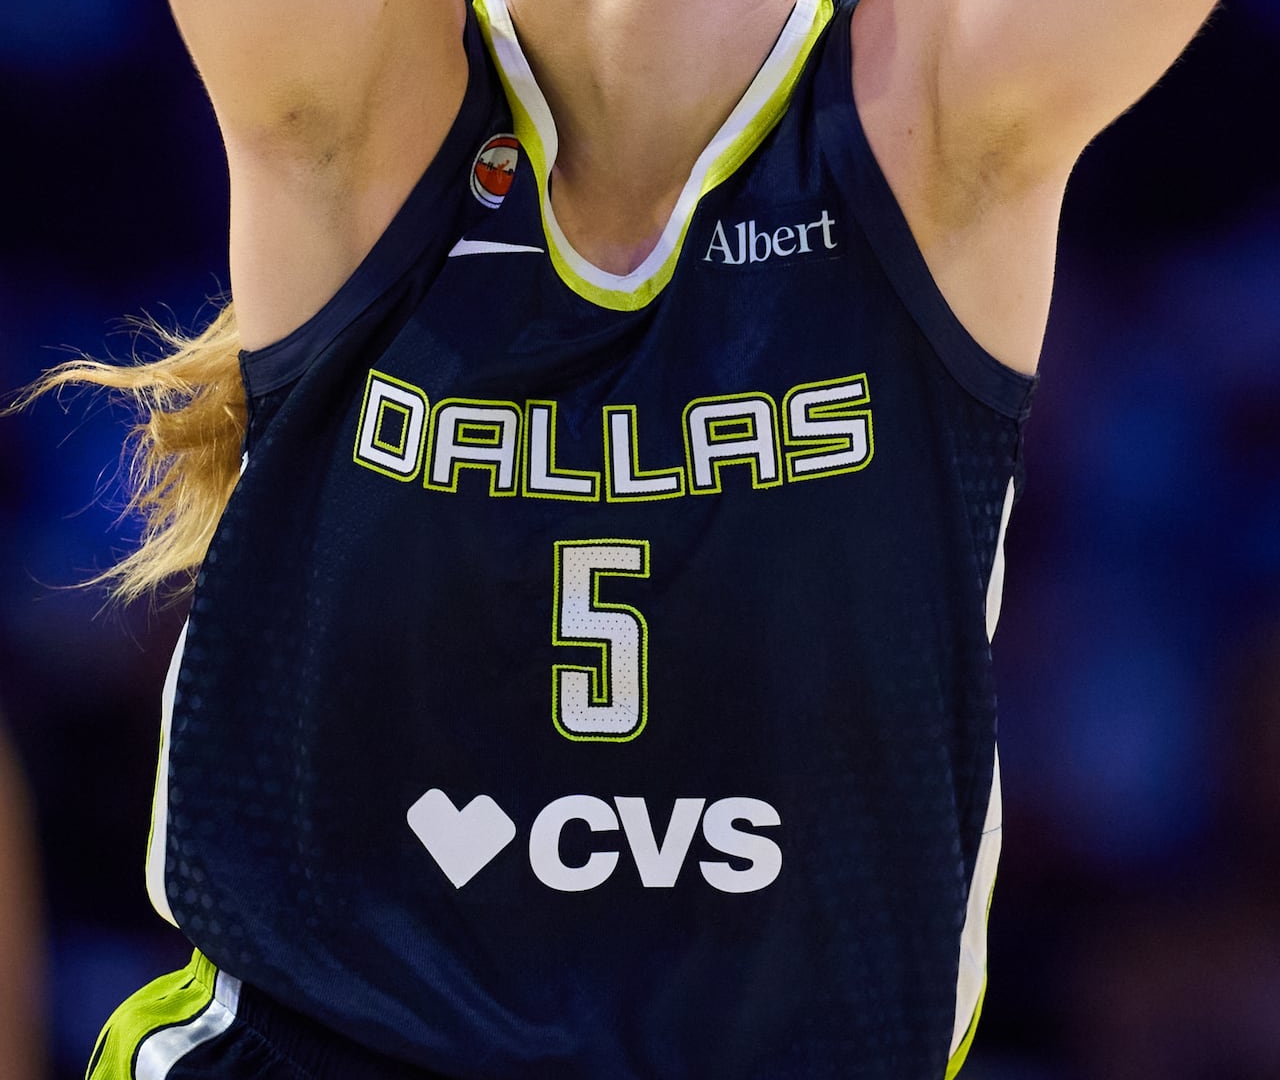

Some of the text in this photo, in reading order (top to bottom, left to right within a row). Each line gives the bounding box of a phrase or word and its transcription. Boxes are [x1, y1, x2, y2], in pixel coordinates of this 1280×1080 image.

[702, 209, 837, 266] Albert
[353, 369, 873, 502] DALLAS
[551, 538, 651, 743] 5
[528, 794, 783, 893] CVS
